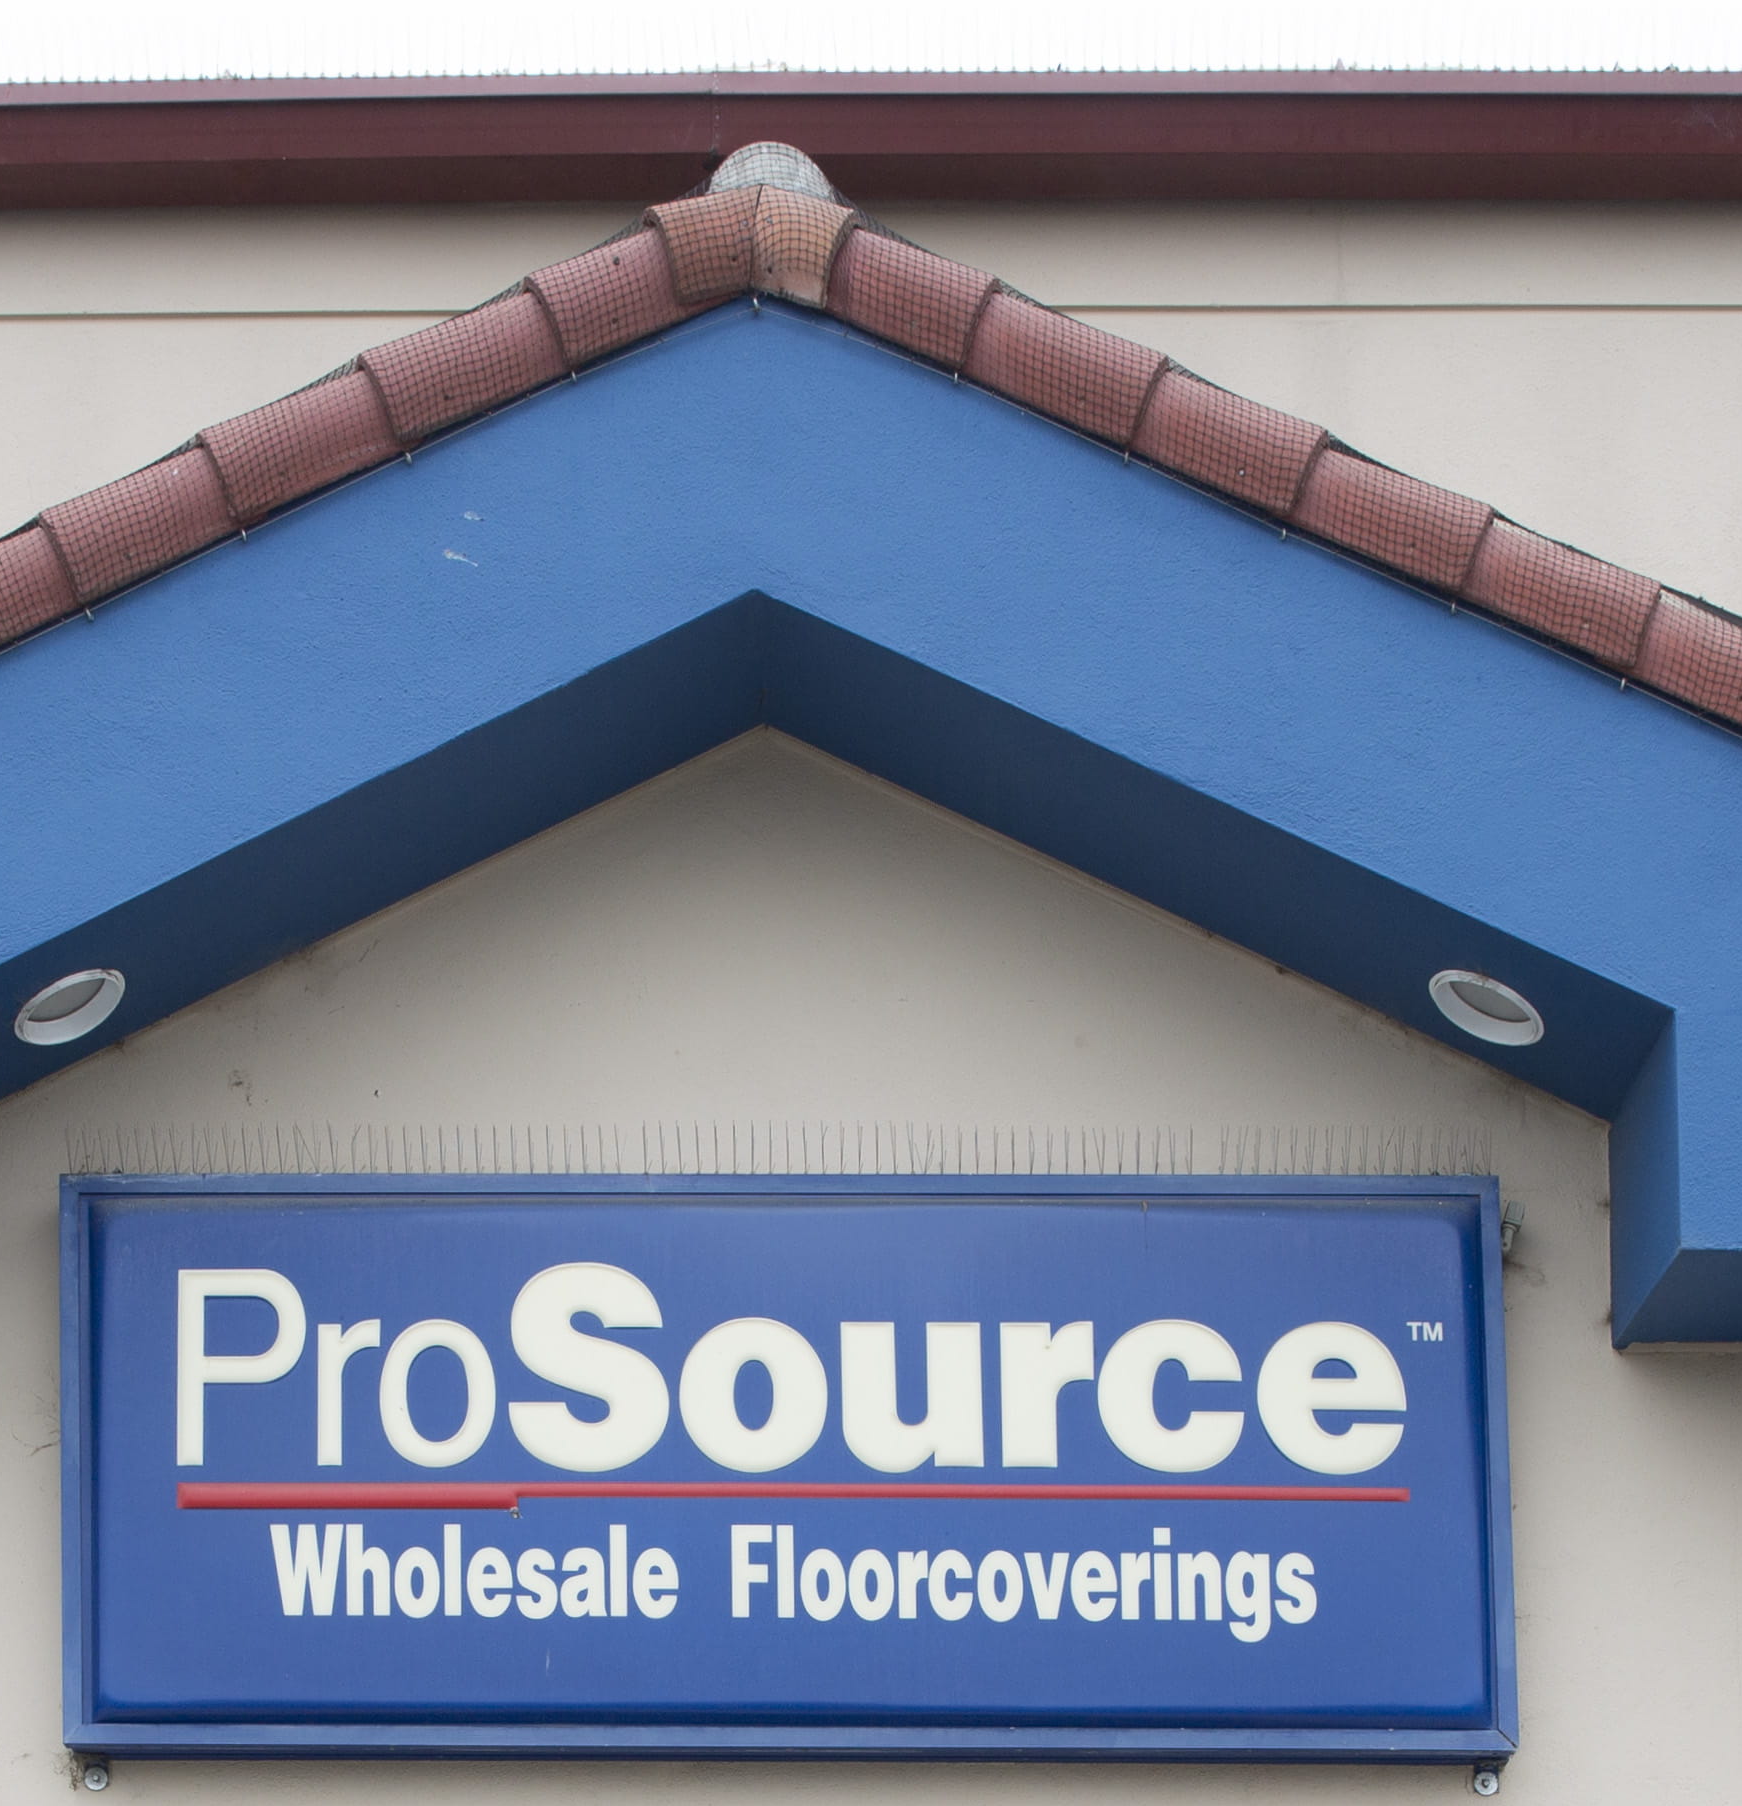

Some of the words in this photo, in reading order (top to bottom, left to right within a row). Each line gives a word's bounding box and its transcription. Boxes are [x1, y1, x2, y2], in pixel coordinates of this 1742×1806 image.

[175, 1261, 1408, 1474] ProSource
[269, 1524, 680, 1621] Wholesale
[730, 1524, 1318, 1643] Floorcoverings
